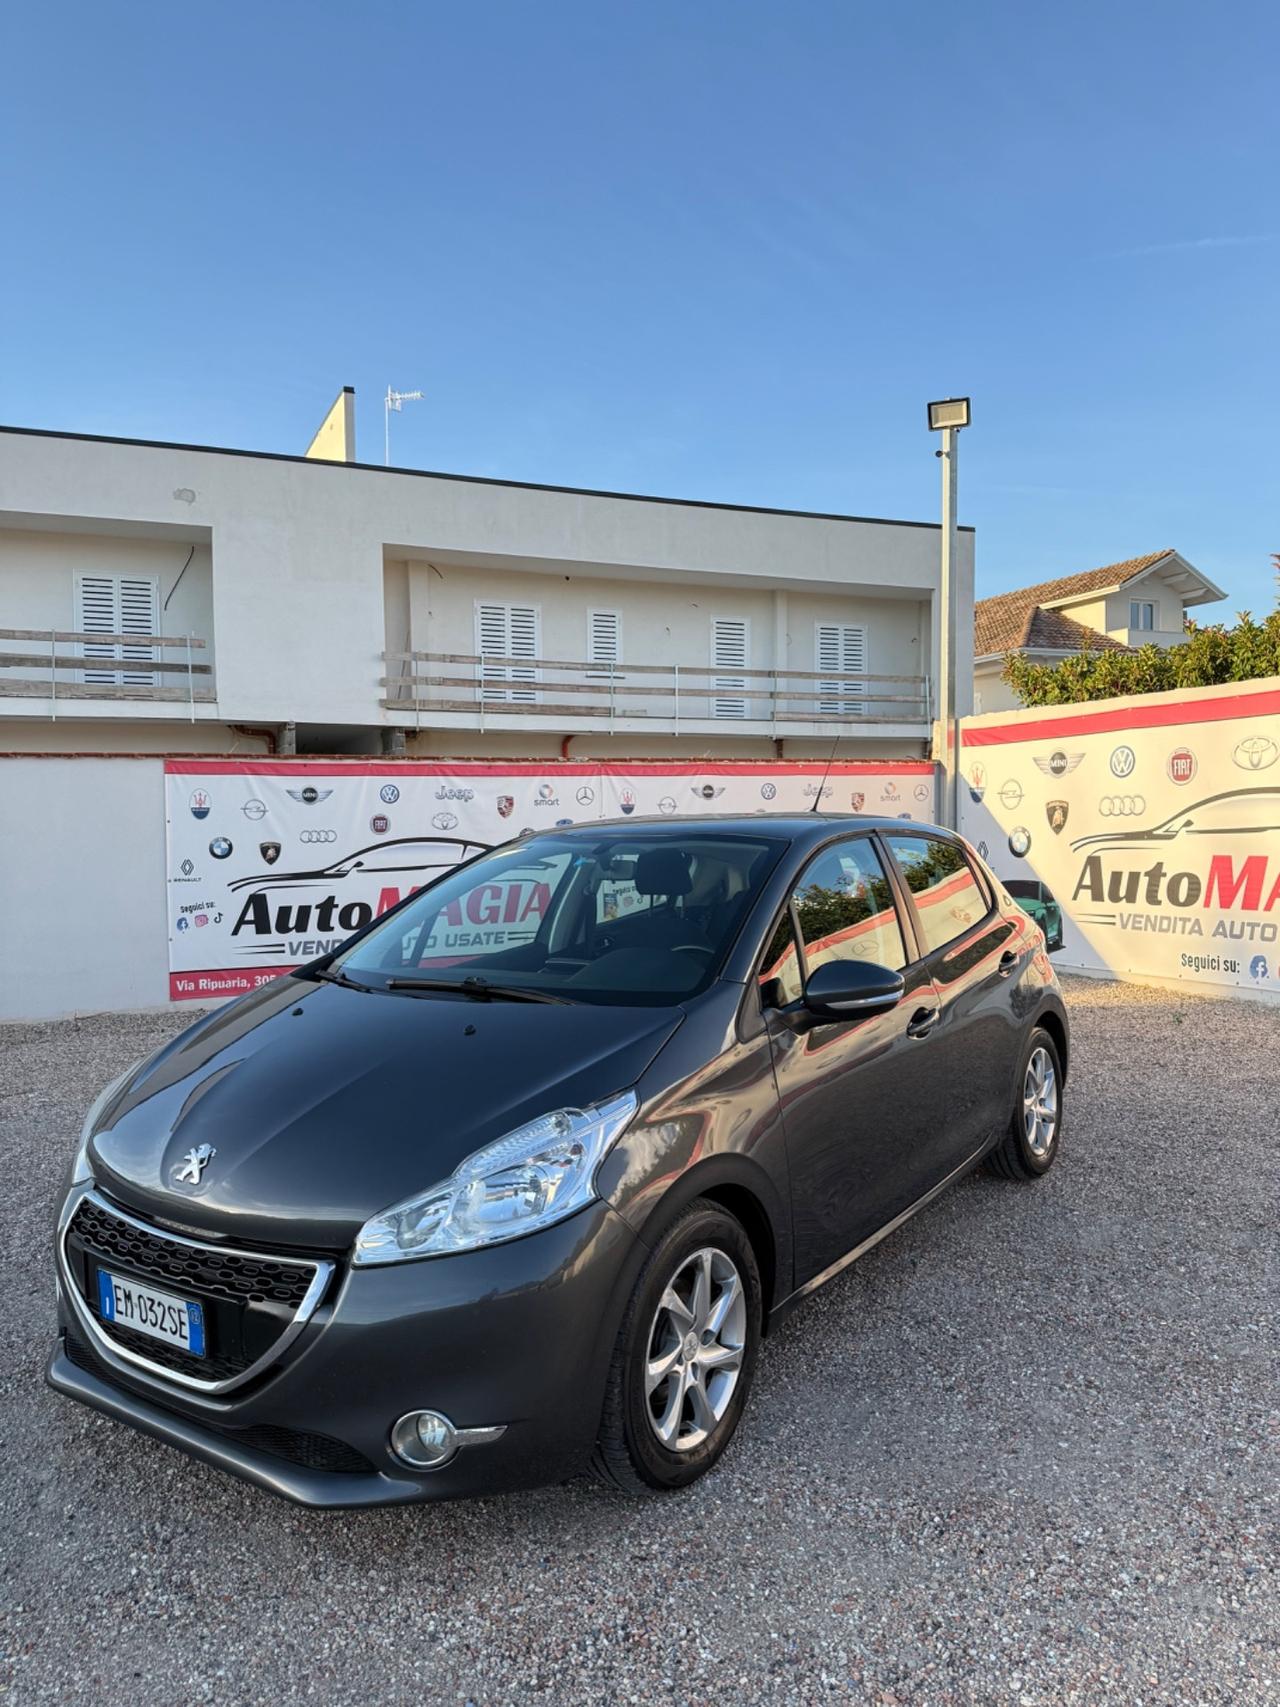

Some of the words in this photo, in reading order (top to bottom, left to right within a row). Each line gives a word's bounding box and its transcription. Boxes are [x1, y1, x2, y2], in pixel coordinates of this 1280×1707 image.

[1050, 759, 1067, 768] MINI
[1173, 758, 1191, 776] FIAT
[435, 785, 474, 802] Jeep
[880, 794, 901, 802] smart
[534, 798, 560, 806] smart
[180, 902, 205, 914] Seguici
[1119, 912, 1204, 937] VENDITA
[1212, 919, 1278, 943] AUTO
[445, 931, 506, 949] USATE
[1181, 952, 1220, 973] Seguici
[1223, 959, 1241, 974] su:
[176, 980, 195, 991] Via
[198, 977, 251, 991] Ripuaria,
